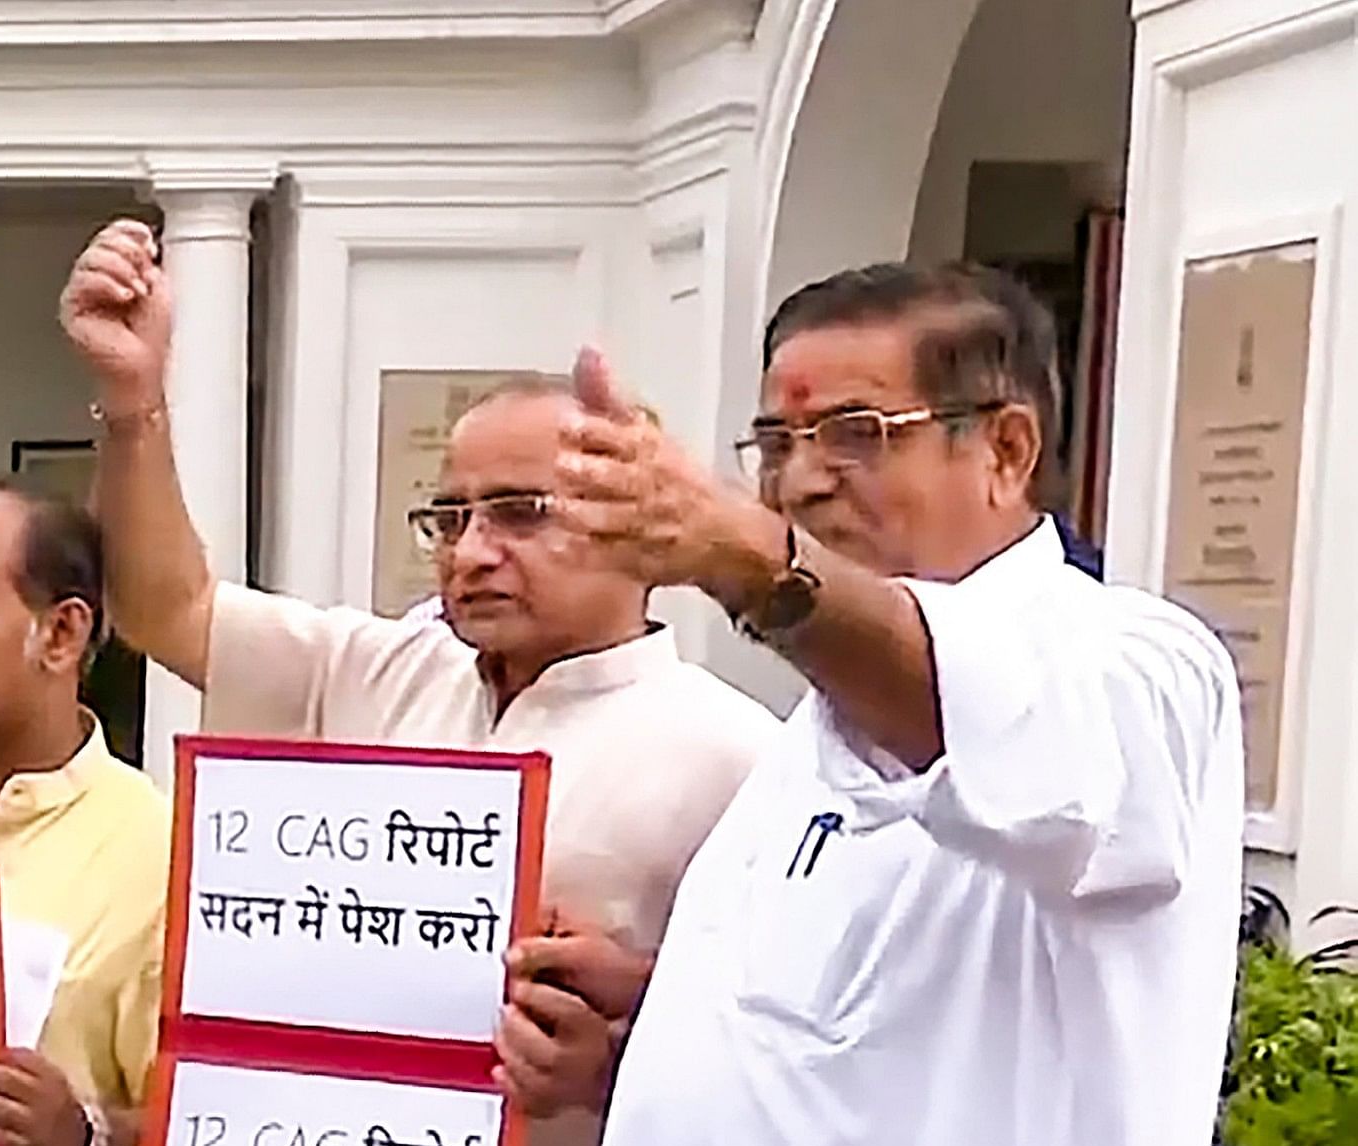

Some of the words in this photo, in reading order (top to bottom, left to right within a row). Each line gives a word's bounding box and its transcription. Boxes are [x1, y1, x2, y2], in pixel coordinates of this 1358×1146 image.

[208, 810, 249, 854] 12
[276, 814, 370, 862] CAG
[384, 808, 502, 869] रिपोर्ट
[198, 891, 287, 939] सदन
[294, 884, 330, 941] में
[337, 887, 407, 947] पेश
[414, 896, 501, 954] करो
